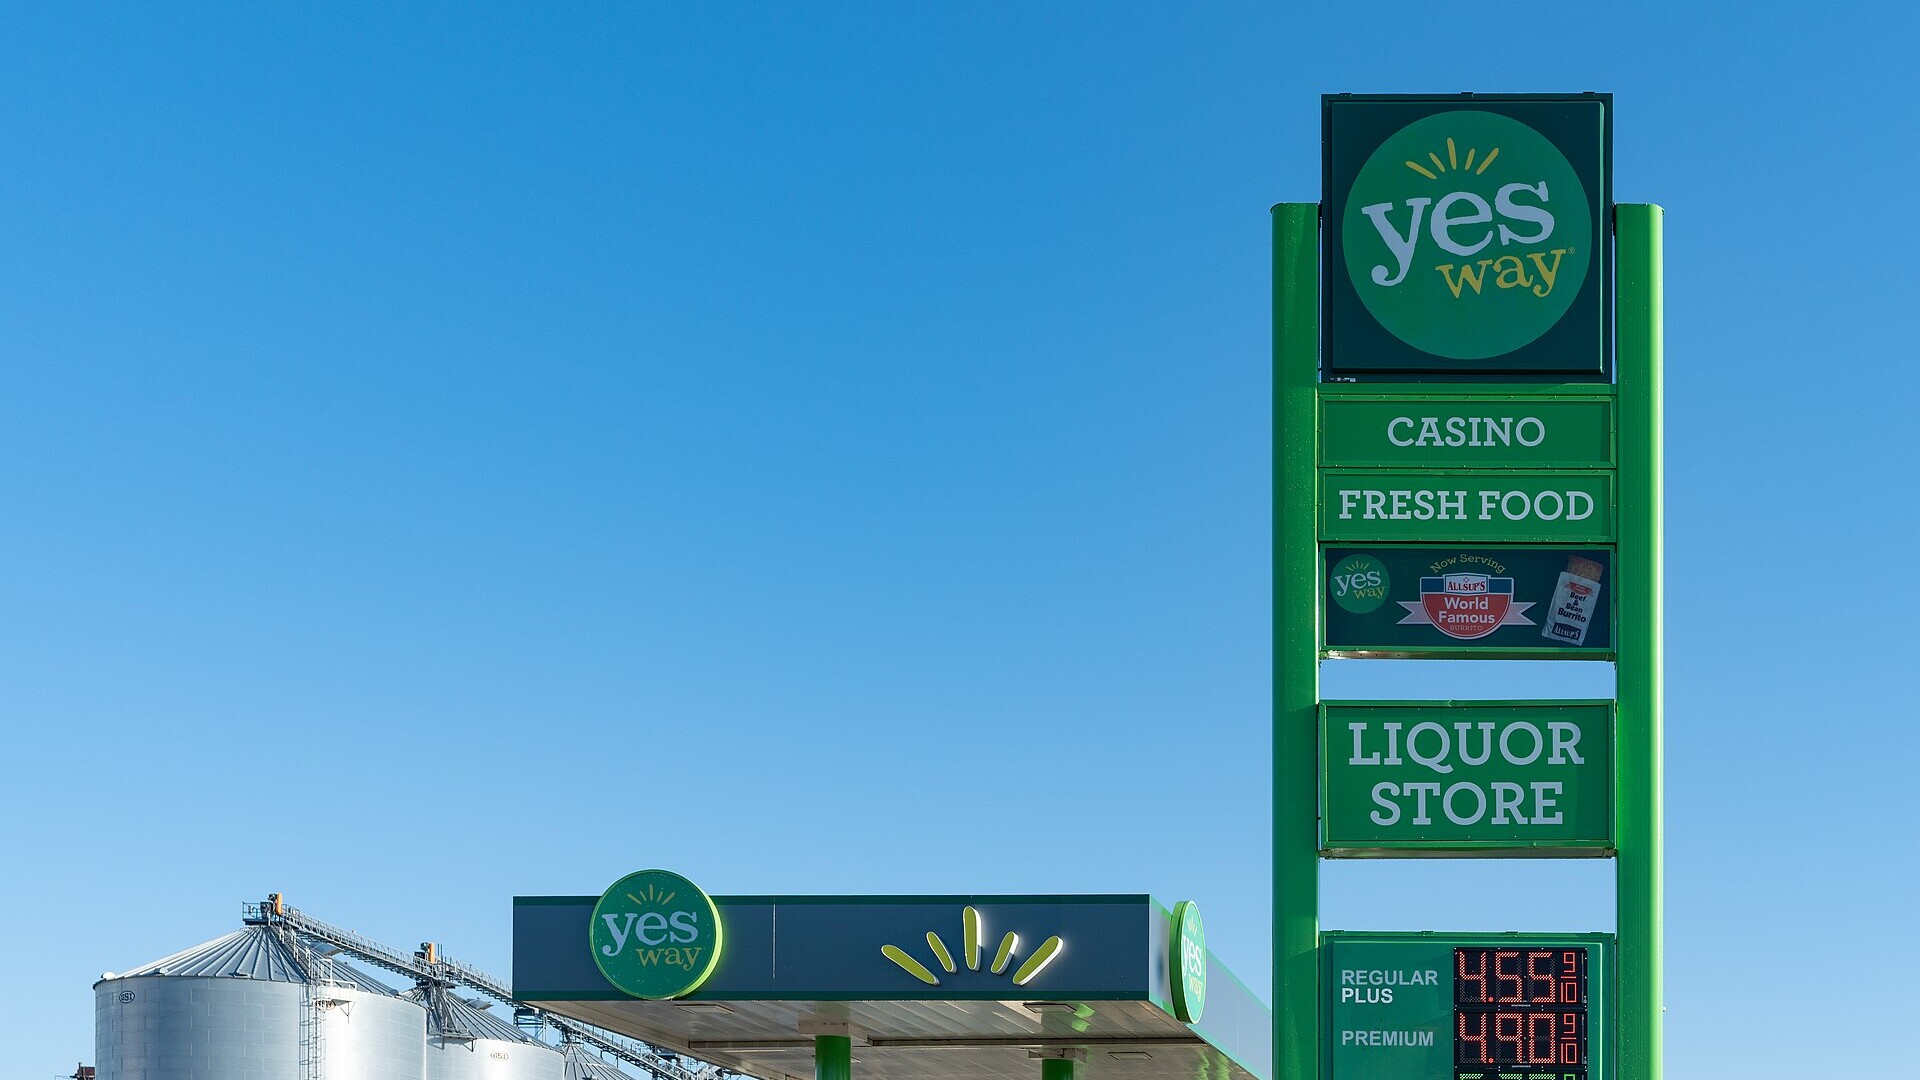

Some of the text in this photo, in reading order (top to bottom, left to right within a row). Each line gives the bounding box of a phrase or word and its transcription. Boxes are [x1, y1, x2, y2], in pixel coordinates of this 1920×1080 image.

[1361, 181, 1554, 286] yes
[1435, 249, 1566, 298] way
[1387, 417, 1545, 447] CASINO
[1339, 490, 1594, 520] FRESH FOOD
[1430, 554, 1506, 574] Now Serving
[1334, 571, 1381, 596] yes
[1353, 586, 1385, 600] way
[1447, 581, 1486, 591] ALLSUP'S
[1444, 597, 1489, 610] World
[1566, 603, 1583, 613] Bean
[1570, 592, 1586, 602] Beef
[1438, 611, 1495, 624] Famous
[1558, 608, 1586, 622] Burrito
[1348, 721, 1585, 774] LIQUOR
[1370, 781, 1563, 826] STORE
[601, 911, 699, 957] yes
[635, 947, 702, 971] way
[1182, 934, 1202, 977] yes
[1341, 969, 1438, 985] REGULAR
[1459, 951, 1555, 1003] 4.55
[1341, 987, 1393, 1003] PLUS
[1342, 1030, 1433, 1046] PREMIUM
[1459, 1013, 1555, 1064] 4.90
